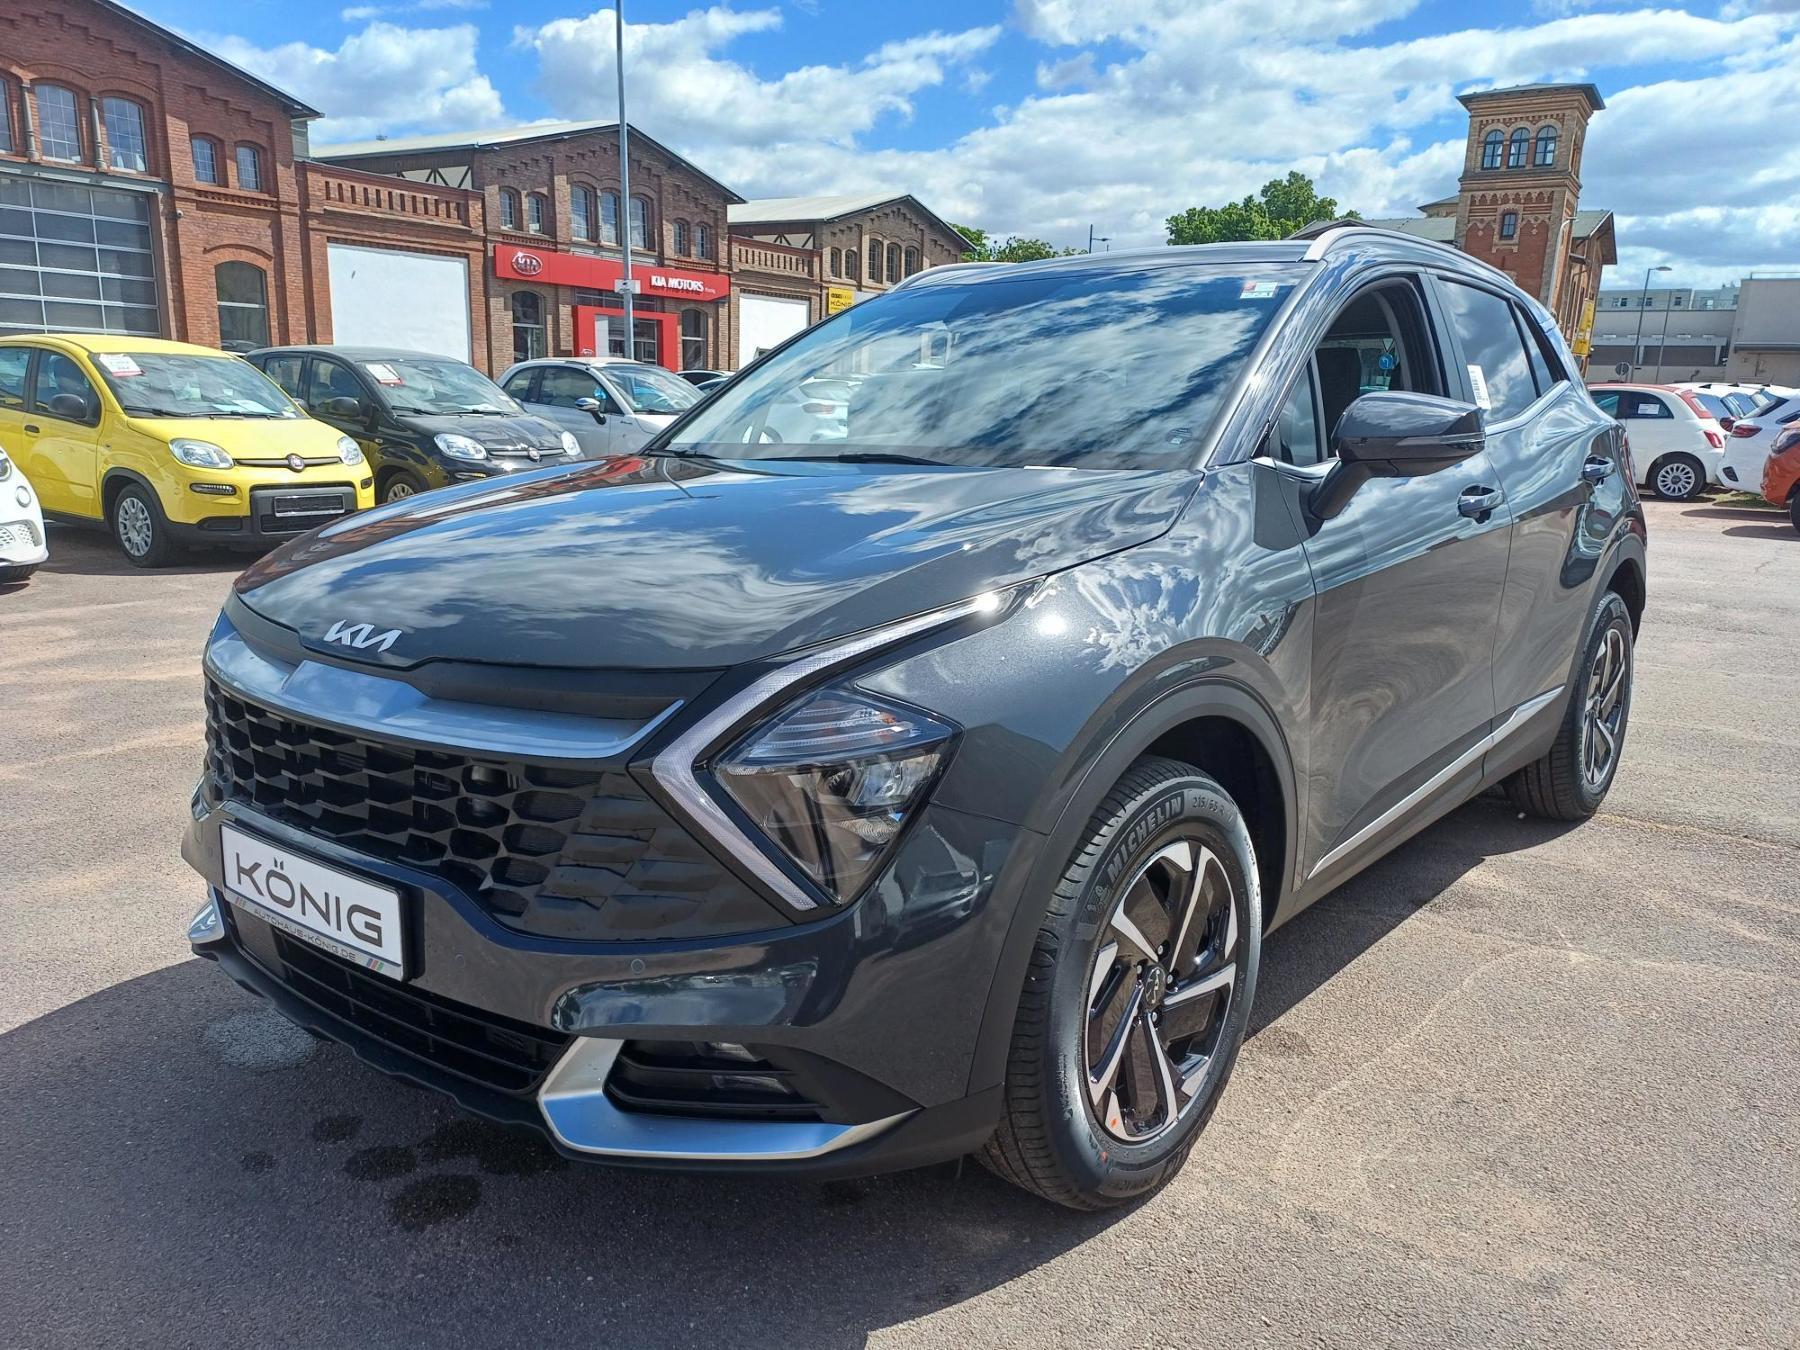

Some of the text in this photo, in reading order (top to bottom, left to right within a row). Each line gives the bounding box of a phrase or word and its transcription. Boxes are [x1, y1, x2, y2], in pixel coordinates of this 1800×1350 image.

[651, 275, 666, 287] KIA
[668, 278, 703, 292] MOTORS
[323, 620, 402, 653] KIA
[1106, 796, 1182, 882] MICHELIN
[235, 852, 383, 948] KÖNIG
